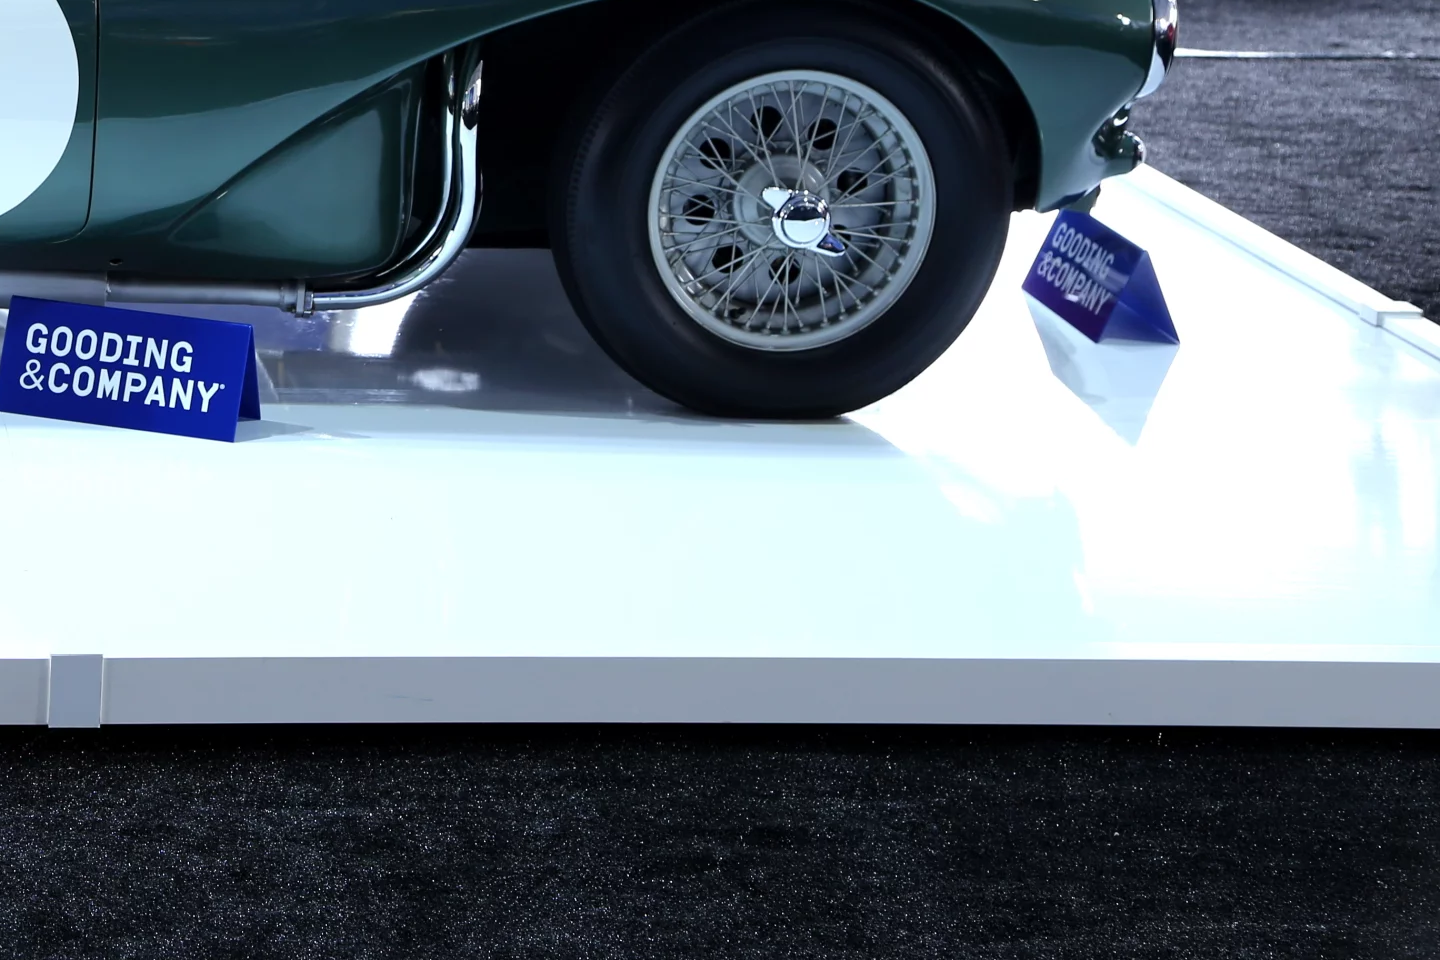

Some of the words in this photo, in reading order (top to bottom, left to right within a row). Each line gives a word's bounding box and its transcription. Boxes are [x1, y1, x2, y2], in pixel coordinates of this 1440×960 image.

[1052, 222, 1115, 281] GOODING
[1037, 250, 1111, 316] &COMPANY
[25, 322, 194, 373] GOODING
[19, 358, 222, 413] &COMPANY
